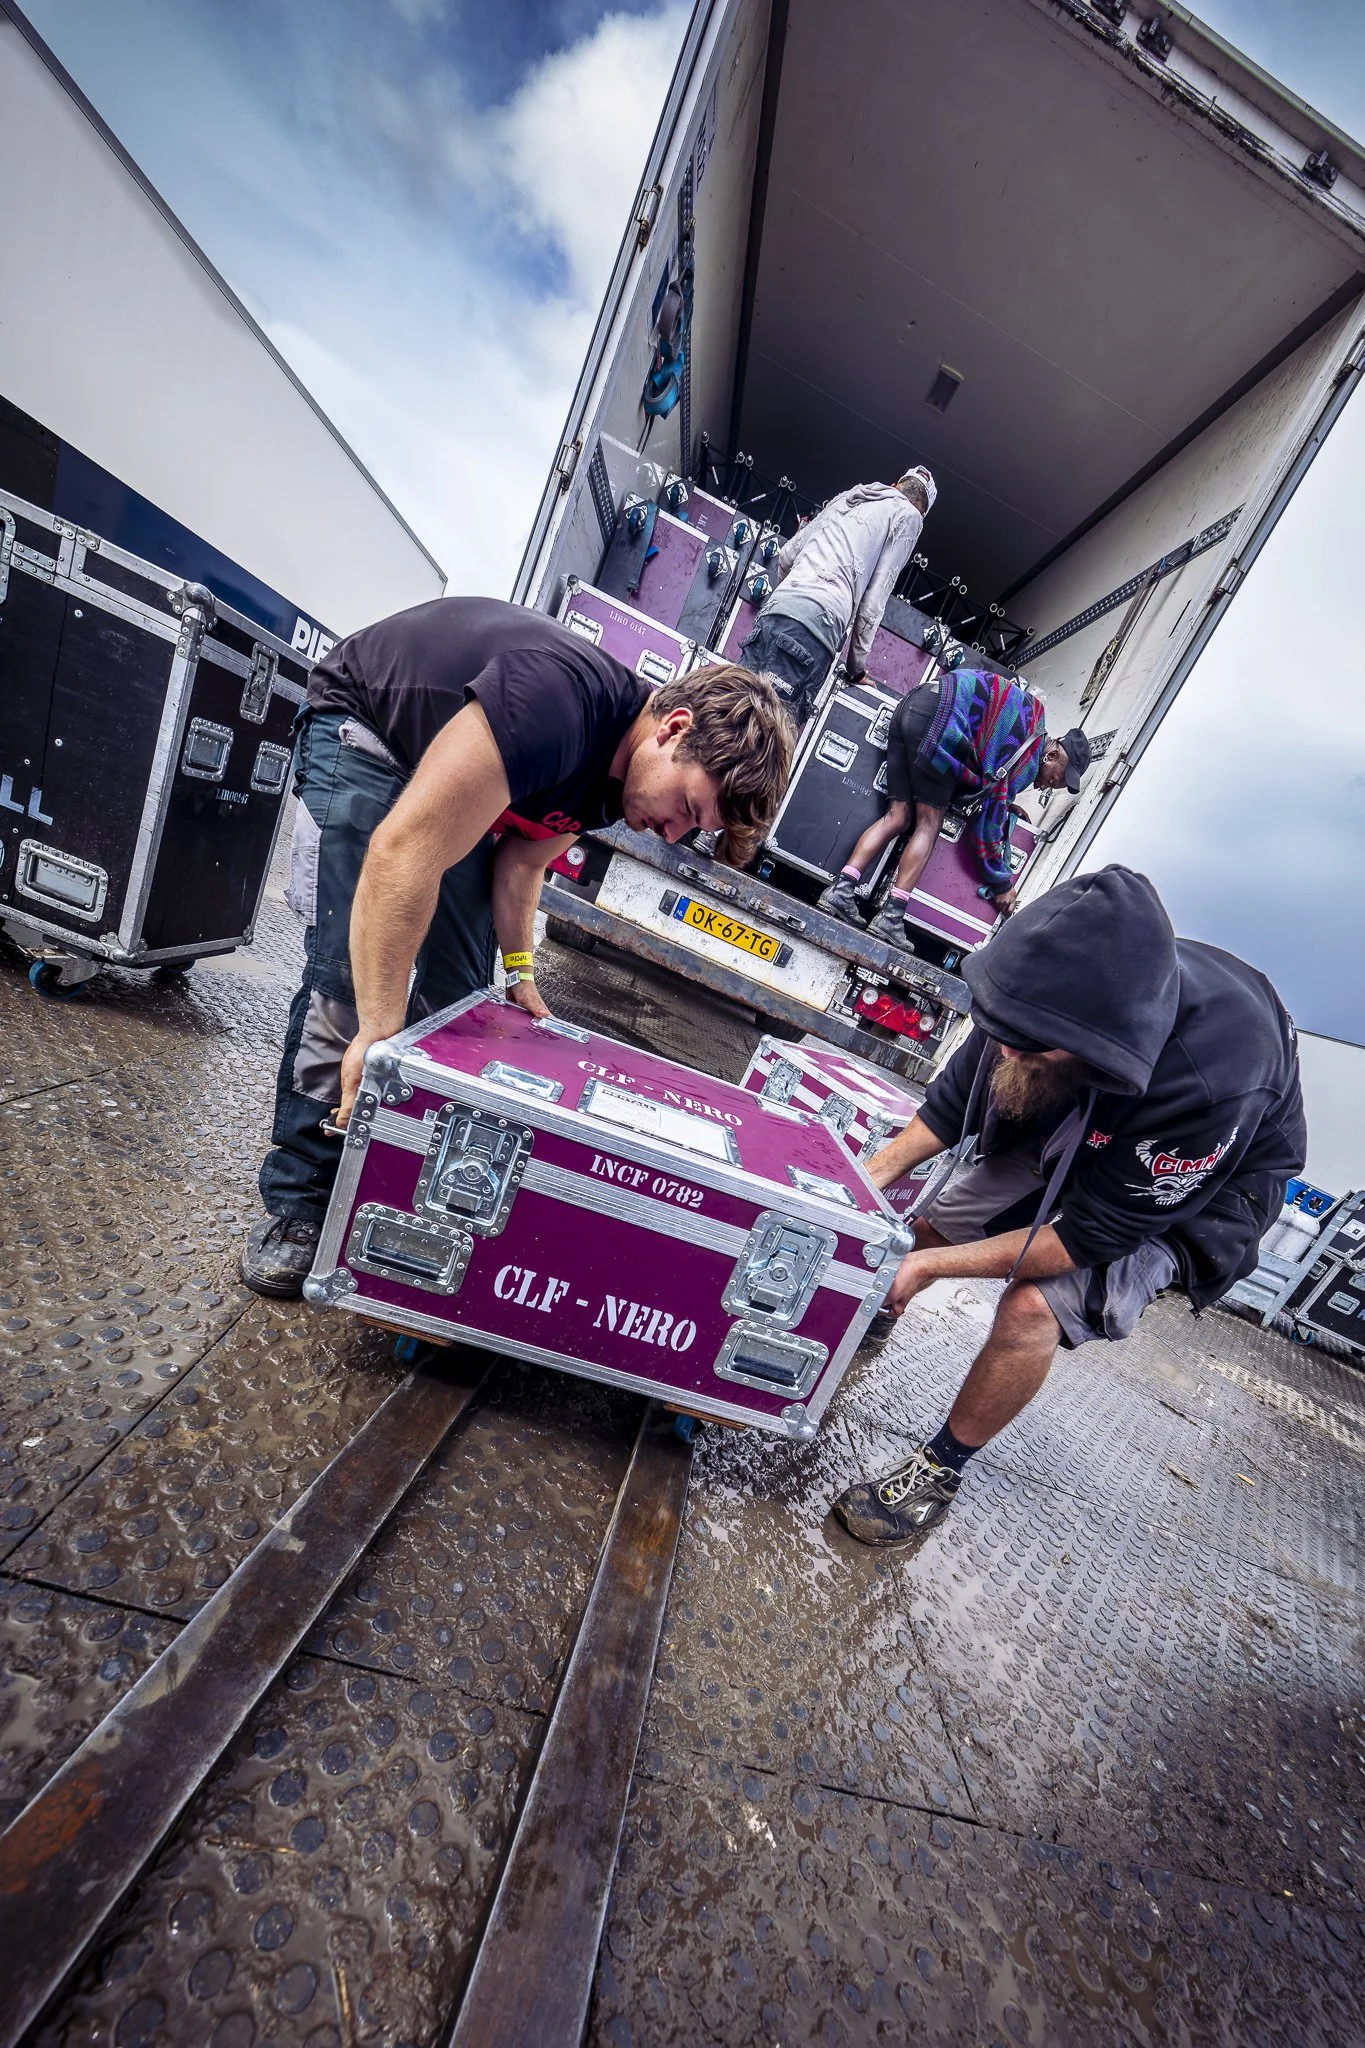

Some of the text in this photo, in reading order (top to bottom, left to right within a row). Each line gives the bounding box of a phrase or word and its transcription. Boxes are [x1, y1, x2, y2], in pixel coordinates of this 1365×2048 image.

[290, 616, 337, 663] PIE
[693, 908, 774, 956] OK-67-TG
[578, 1060, 636, 1085] CLF
[662, 1090, 744, 1127] NERO
[589, 1154, 705, 1207] INCF 0782
[494, 1264, 571, 1314] CLF
[592, 1294, 698, 1354] NERO
